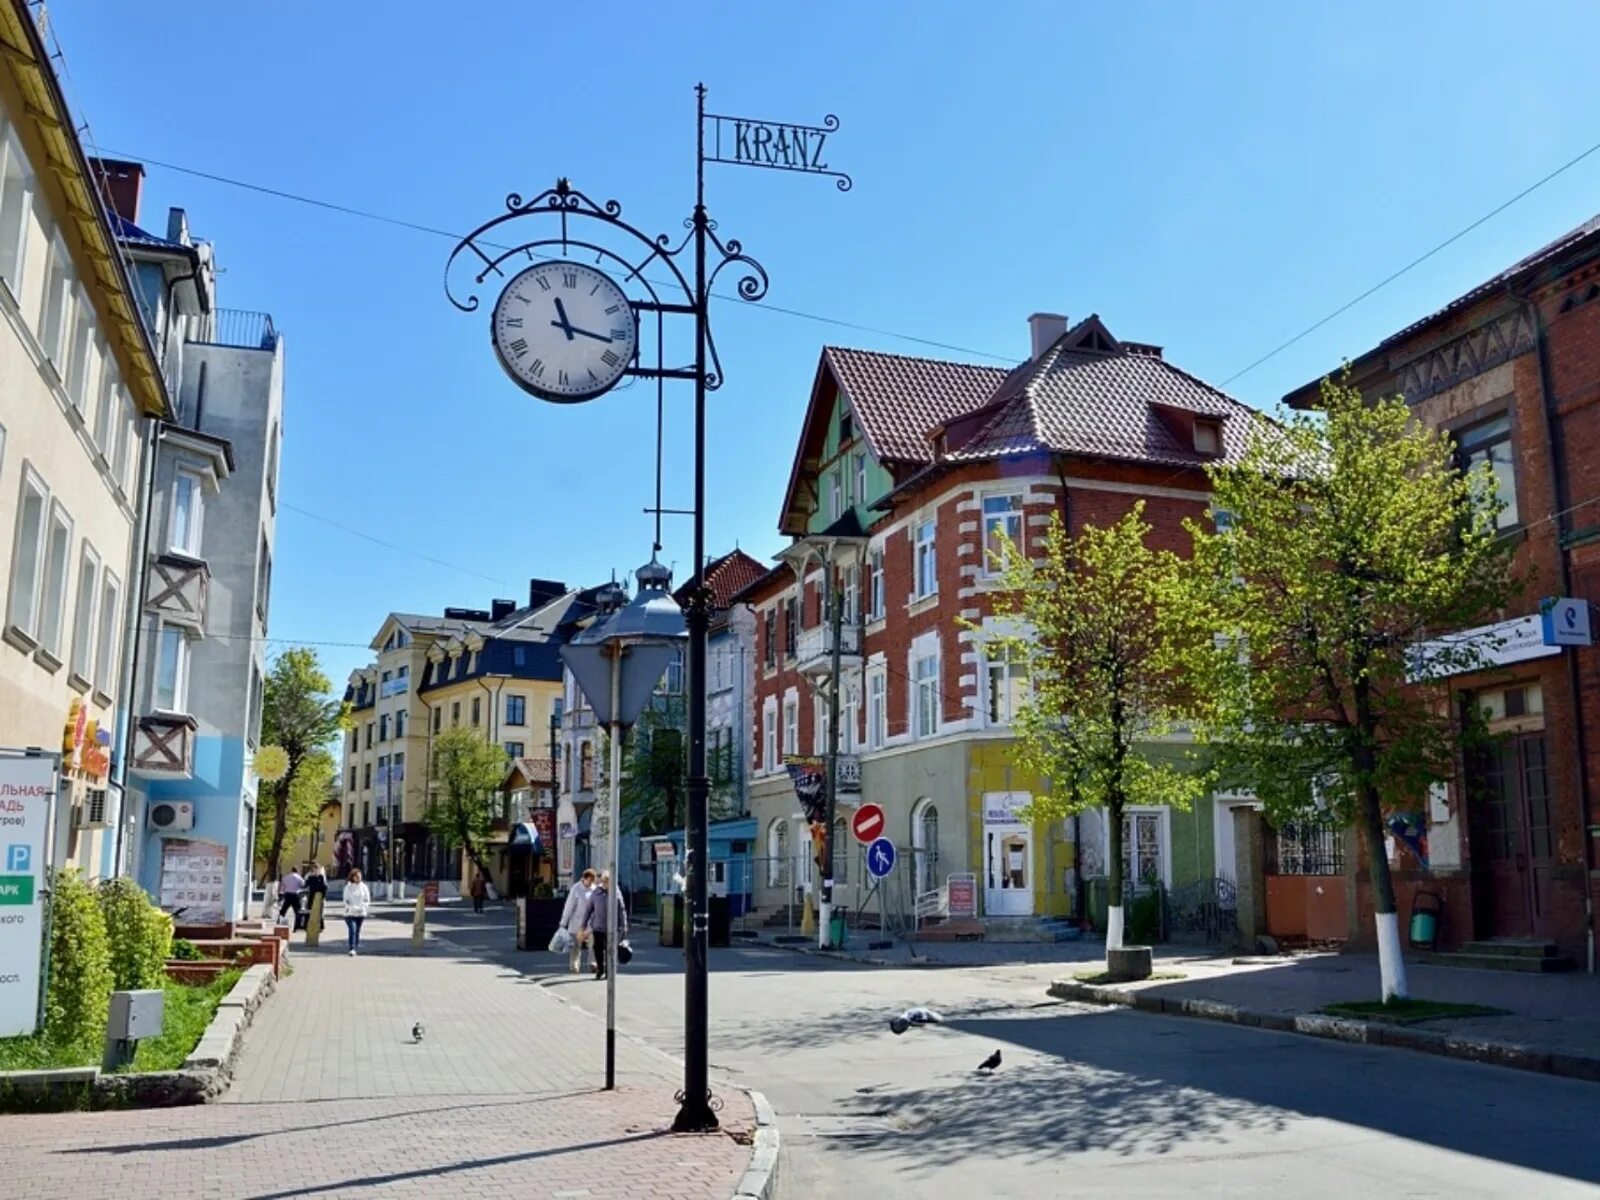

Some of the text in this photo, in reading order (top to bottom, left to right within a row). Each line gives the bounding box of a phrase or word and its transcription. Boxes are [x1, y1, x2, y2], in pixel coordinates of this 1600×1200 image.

[734, 122, 828, 168] KRANZ
[562, 272, 577, 289] XII
[604, 304, 620, 316] II
[610, 328, 626, 341] III
